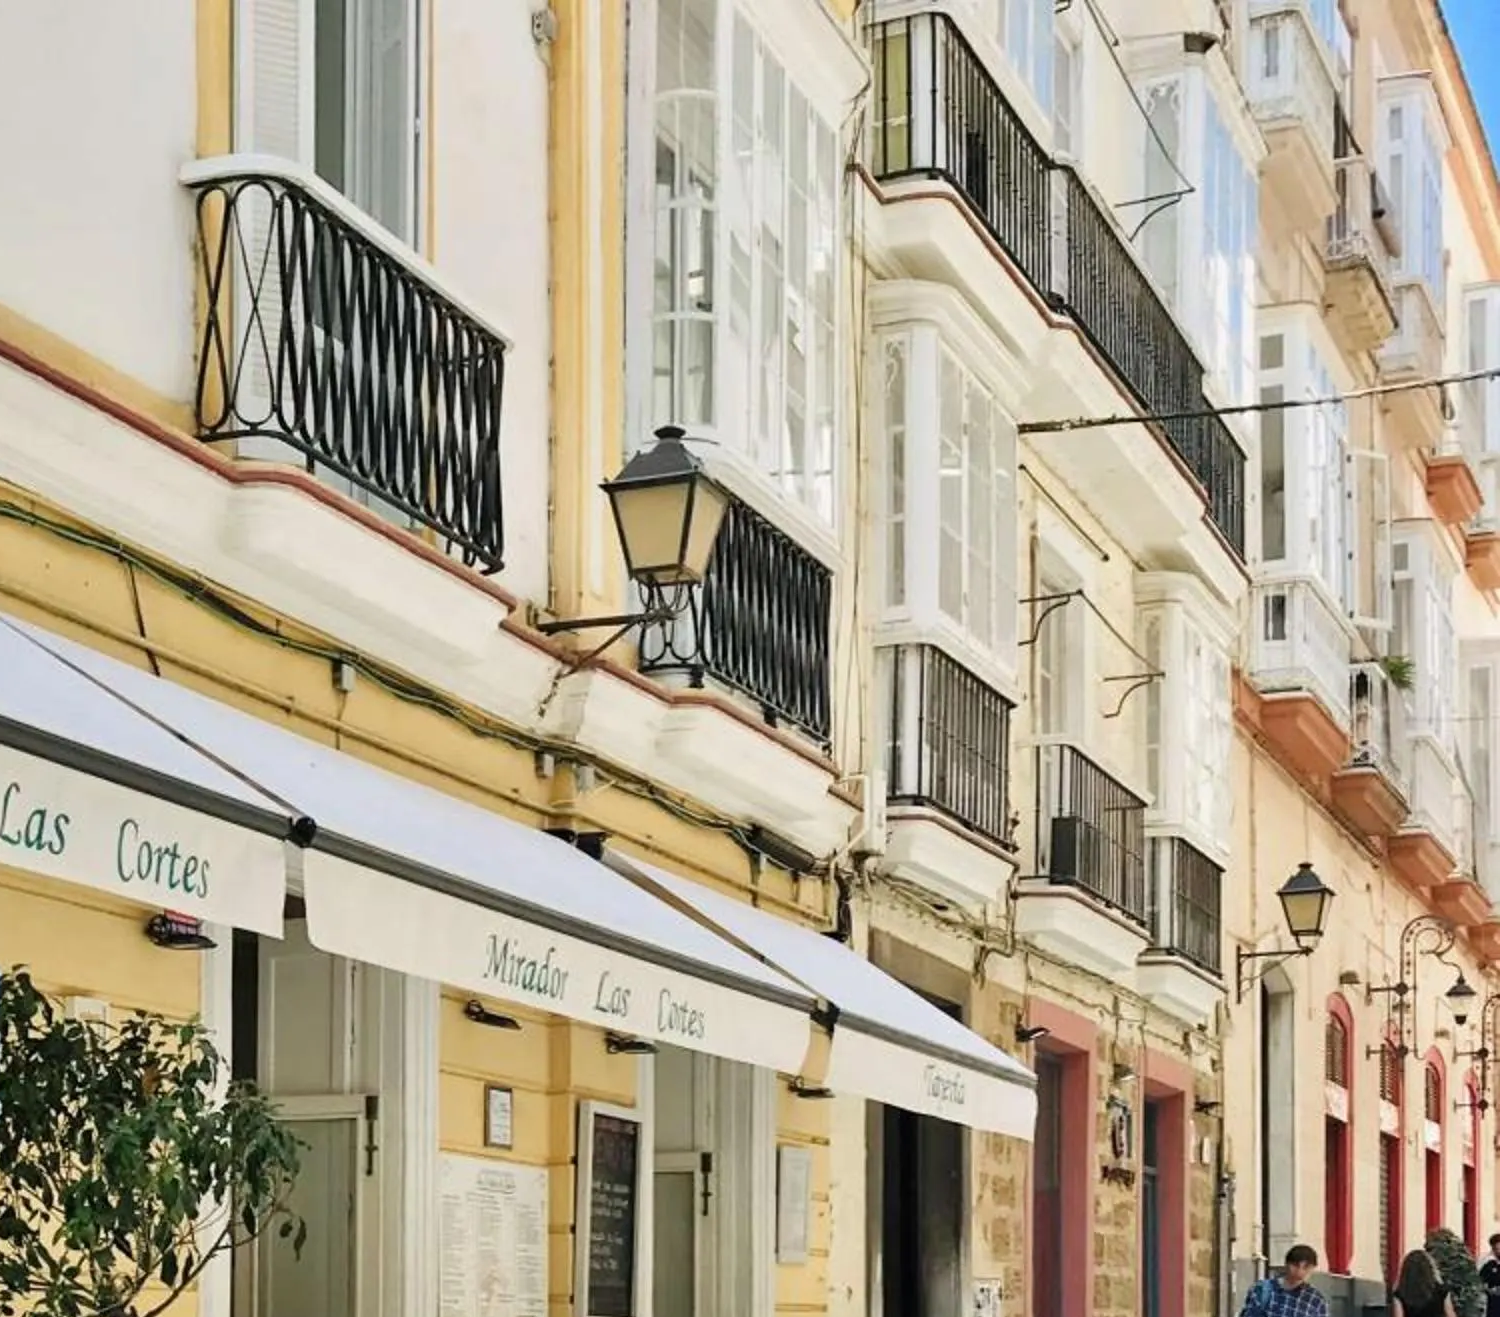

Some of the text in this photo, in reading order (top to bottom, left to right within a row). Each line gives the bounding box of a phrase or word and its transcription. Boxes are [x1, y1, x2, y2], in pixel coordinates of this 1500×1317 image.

[116, 818, 211, 900] Cortes
[483, 934, 706, 1039] Mirador Las Cortes
